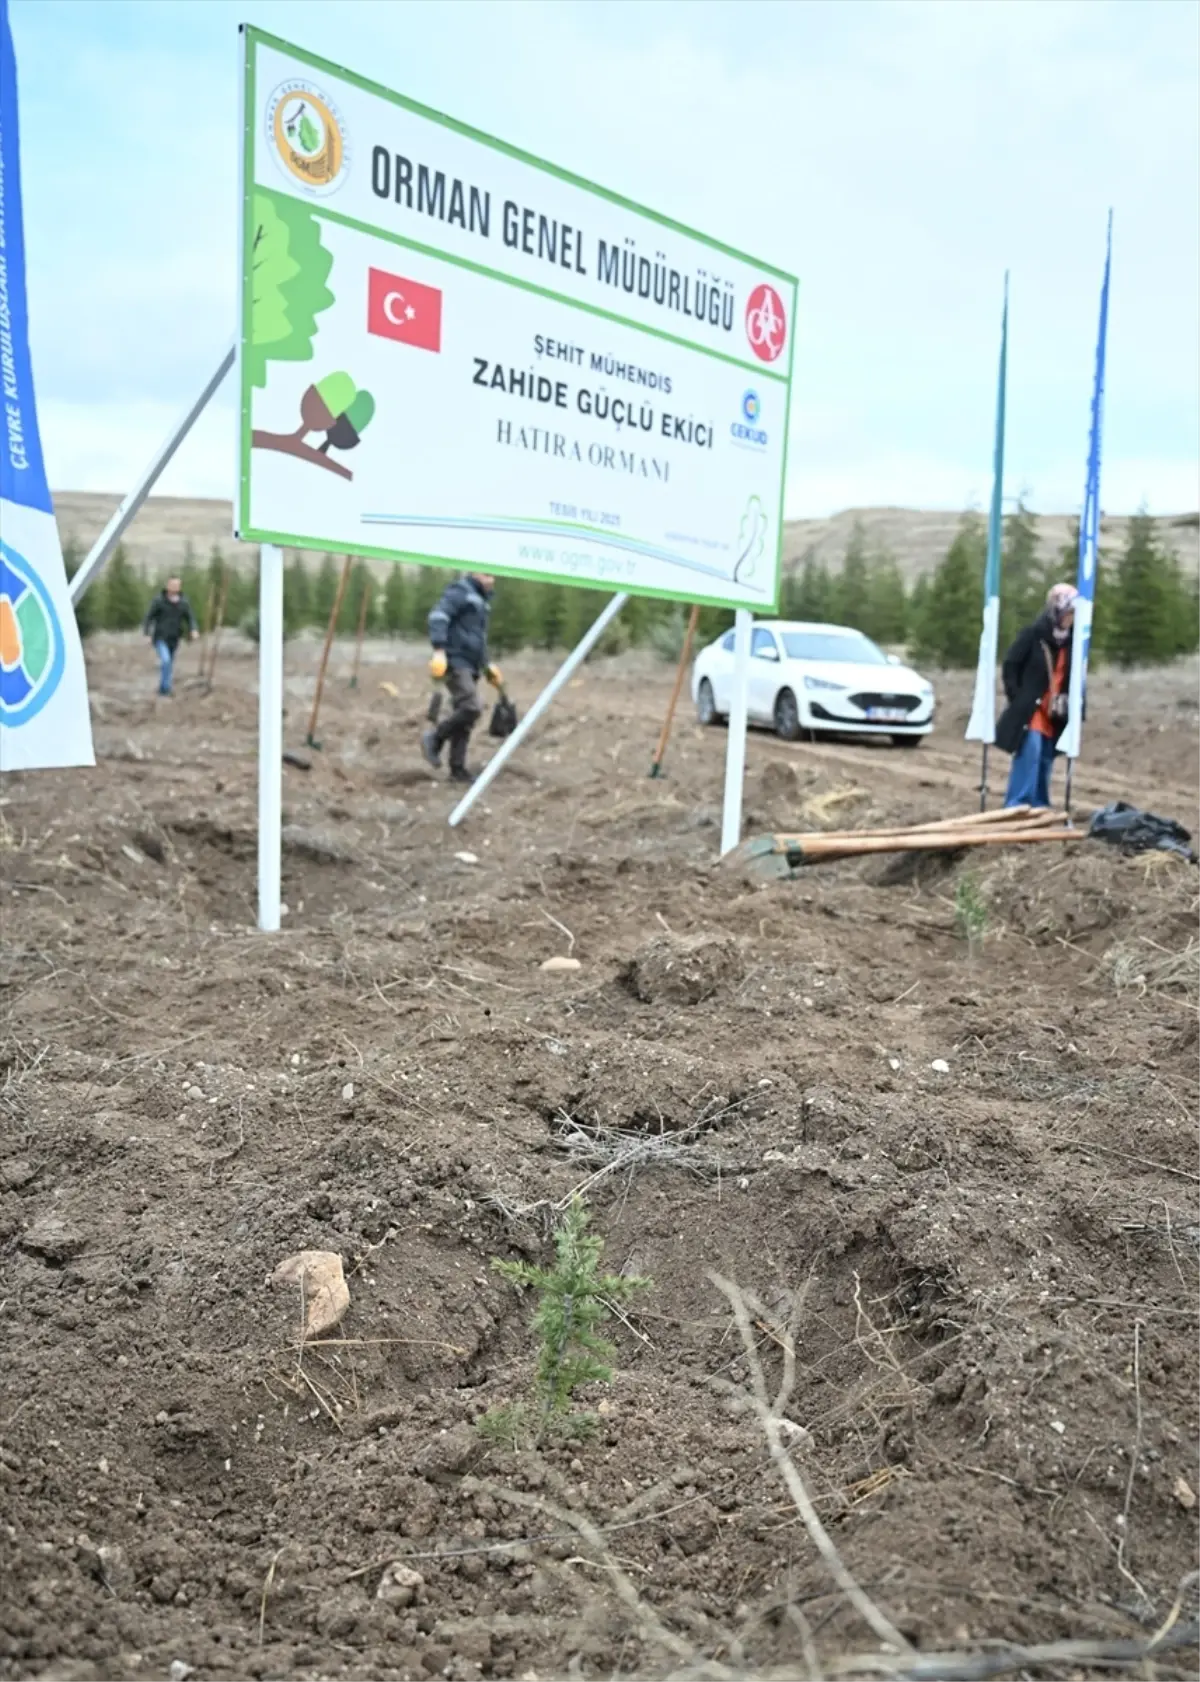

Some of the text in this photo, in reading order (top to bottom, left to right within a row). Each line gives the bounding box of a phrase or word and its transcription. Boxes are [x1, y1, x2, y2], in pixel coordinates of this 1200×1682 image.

[371, 144, 734, 331] ORMAN GENEL MÜDÜRLÜĞÜ
[533, 333, 585, 366] ŞEHİT
[5, 402, 29, 471] ÇEVRE
[472, 357, 714, 450] ZAHİDE GÜÇLÜ EKİCİ
[496, 417, 670, 483] HATIRA ORMANI
